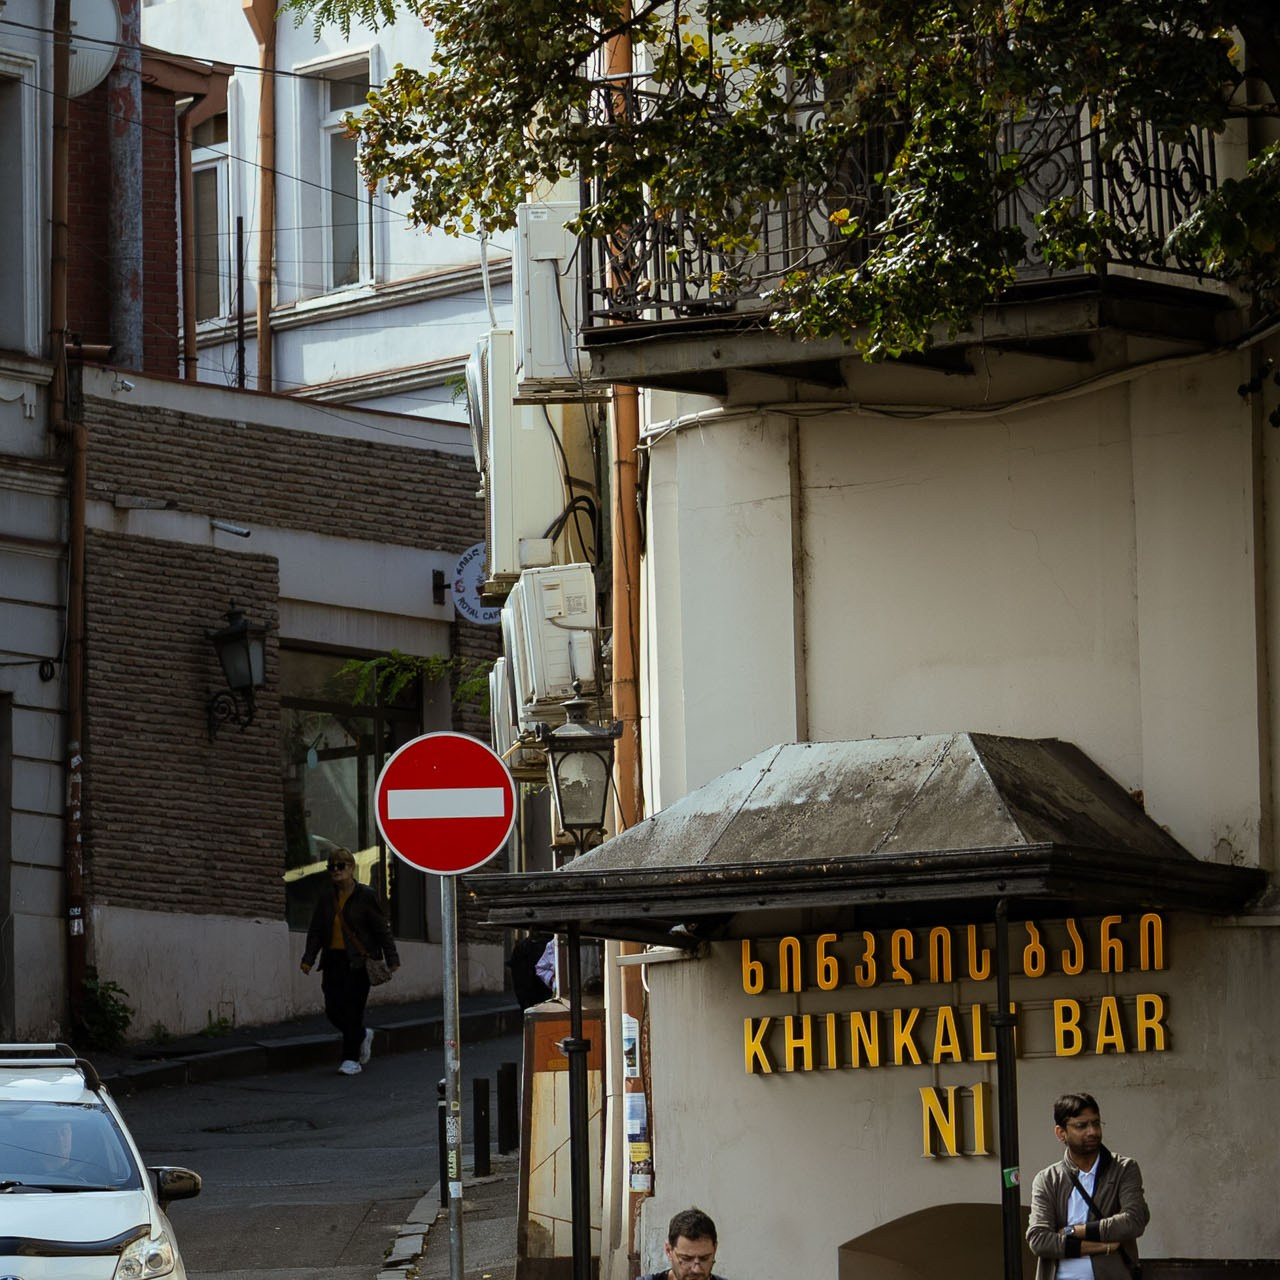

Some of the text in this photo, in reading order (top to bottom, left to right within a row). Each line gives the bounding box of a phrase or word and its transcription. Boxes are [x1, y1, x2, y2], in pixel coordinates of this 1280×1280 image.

[457, 596, 479, 619] ROYAL
[1023, 912, 1164, 978] ბარი
[1053, 993, 1166, 1058] BAR
[919, 1080, 991, 1158] N1
